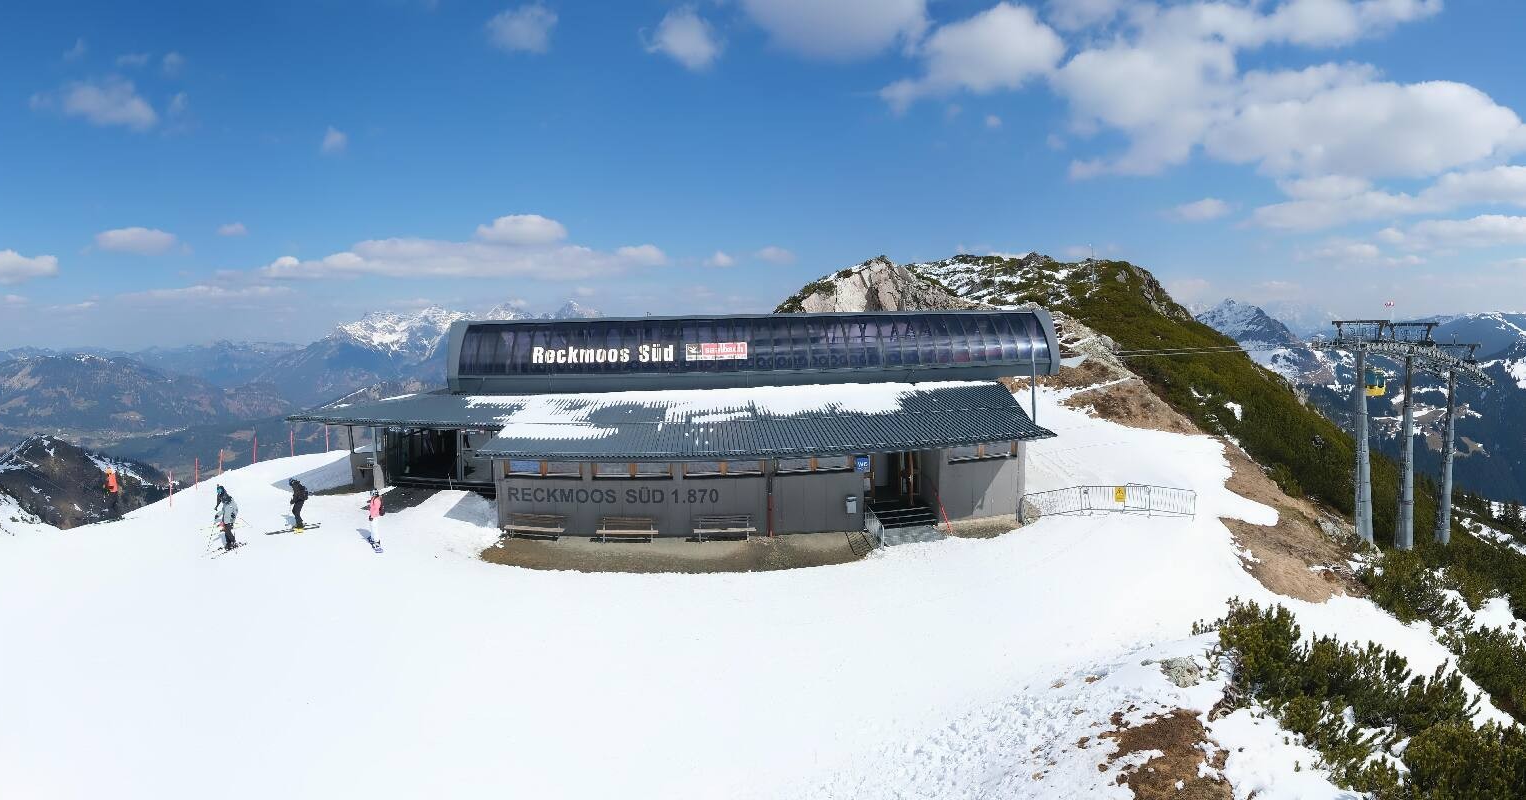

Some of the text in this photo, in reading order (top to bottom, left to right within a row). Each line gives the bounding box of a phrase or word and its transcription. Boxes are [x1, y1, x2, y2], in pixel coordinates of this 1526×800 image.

[532, 344, 674, 364] Reckmoos Süd
[507, 486, 719, 504] RECKMOOS SÜD 1.870
